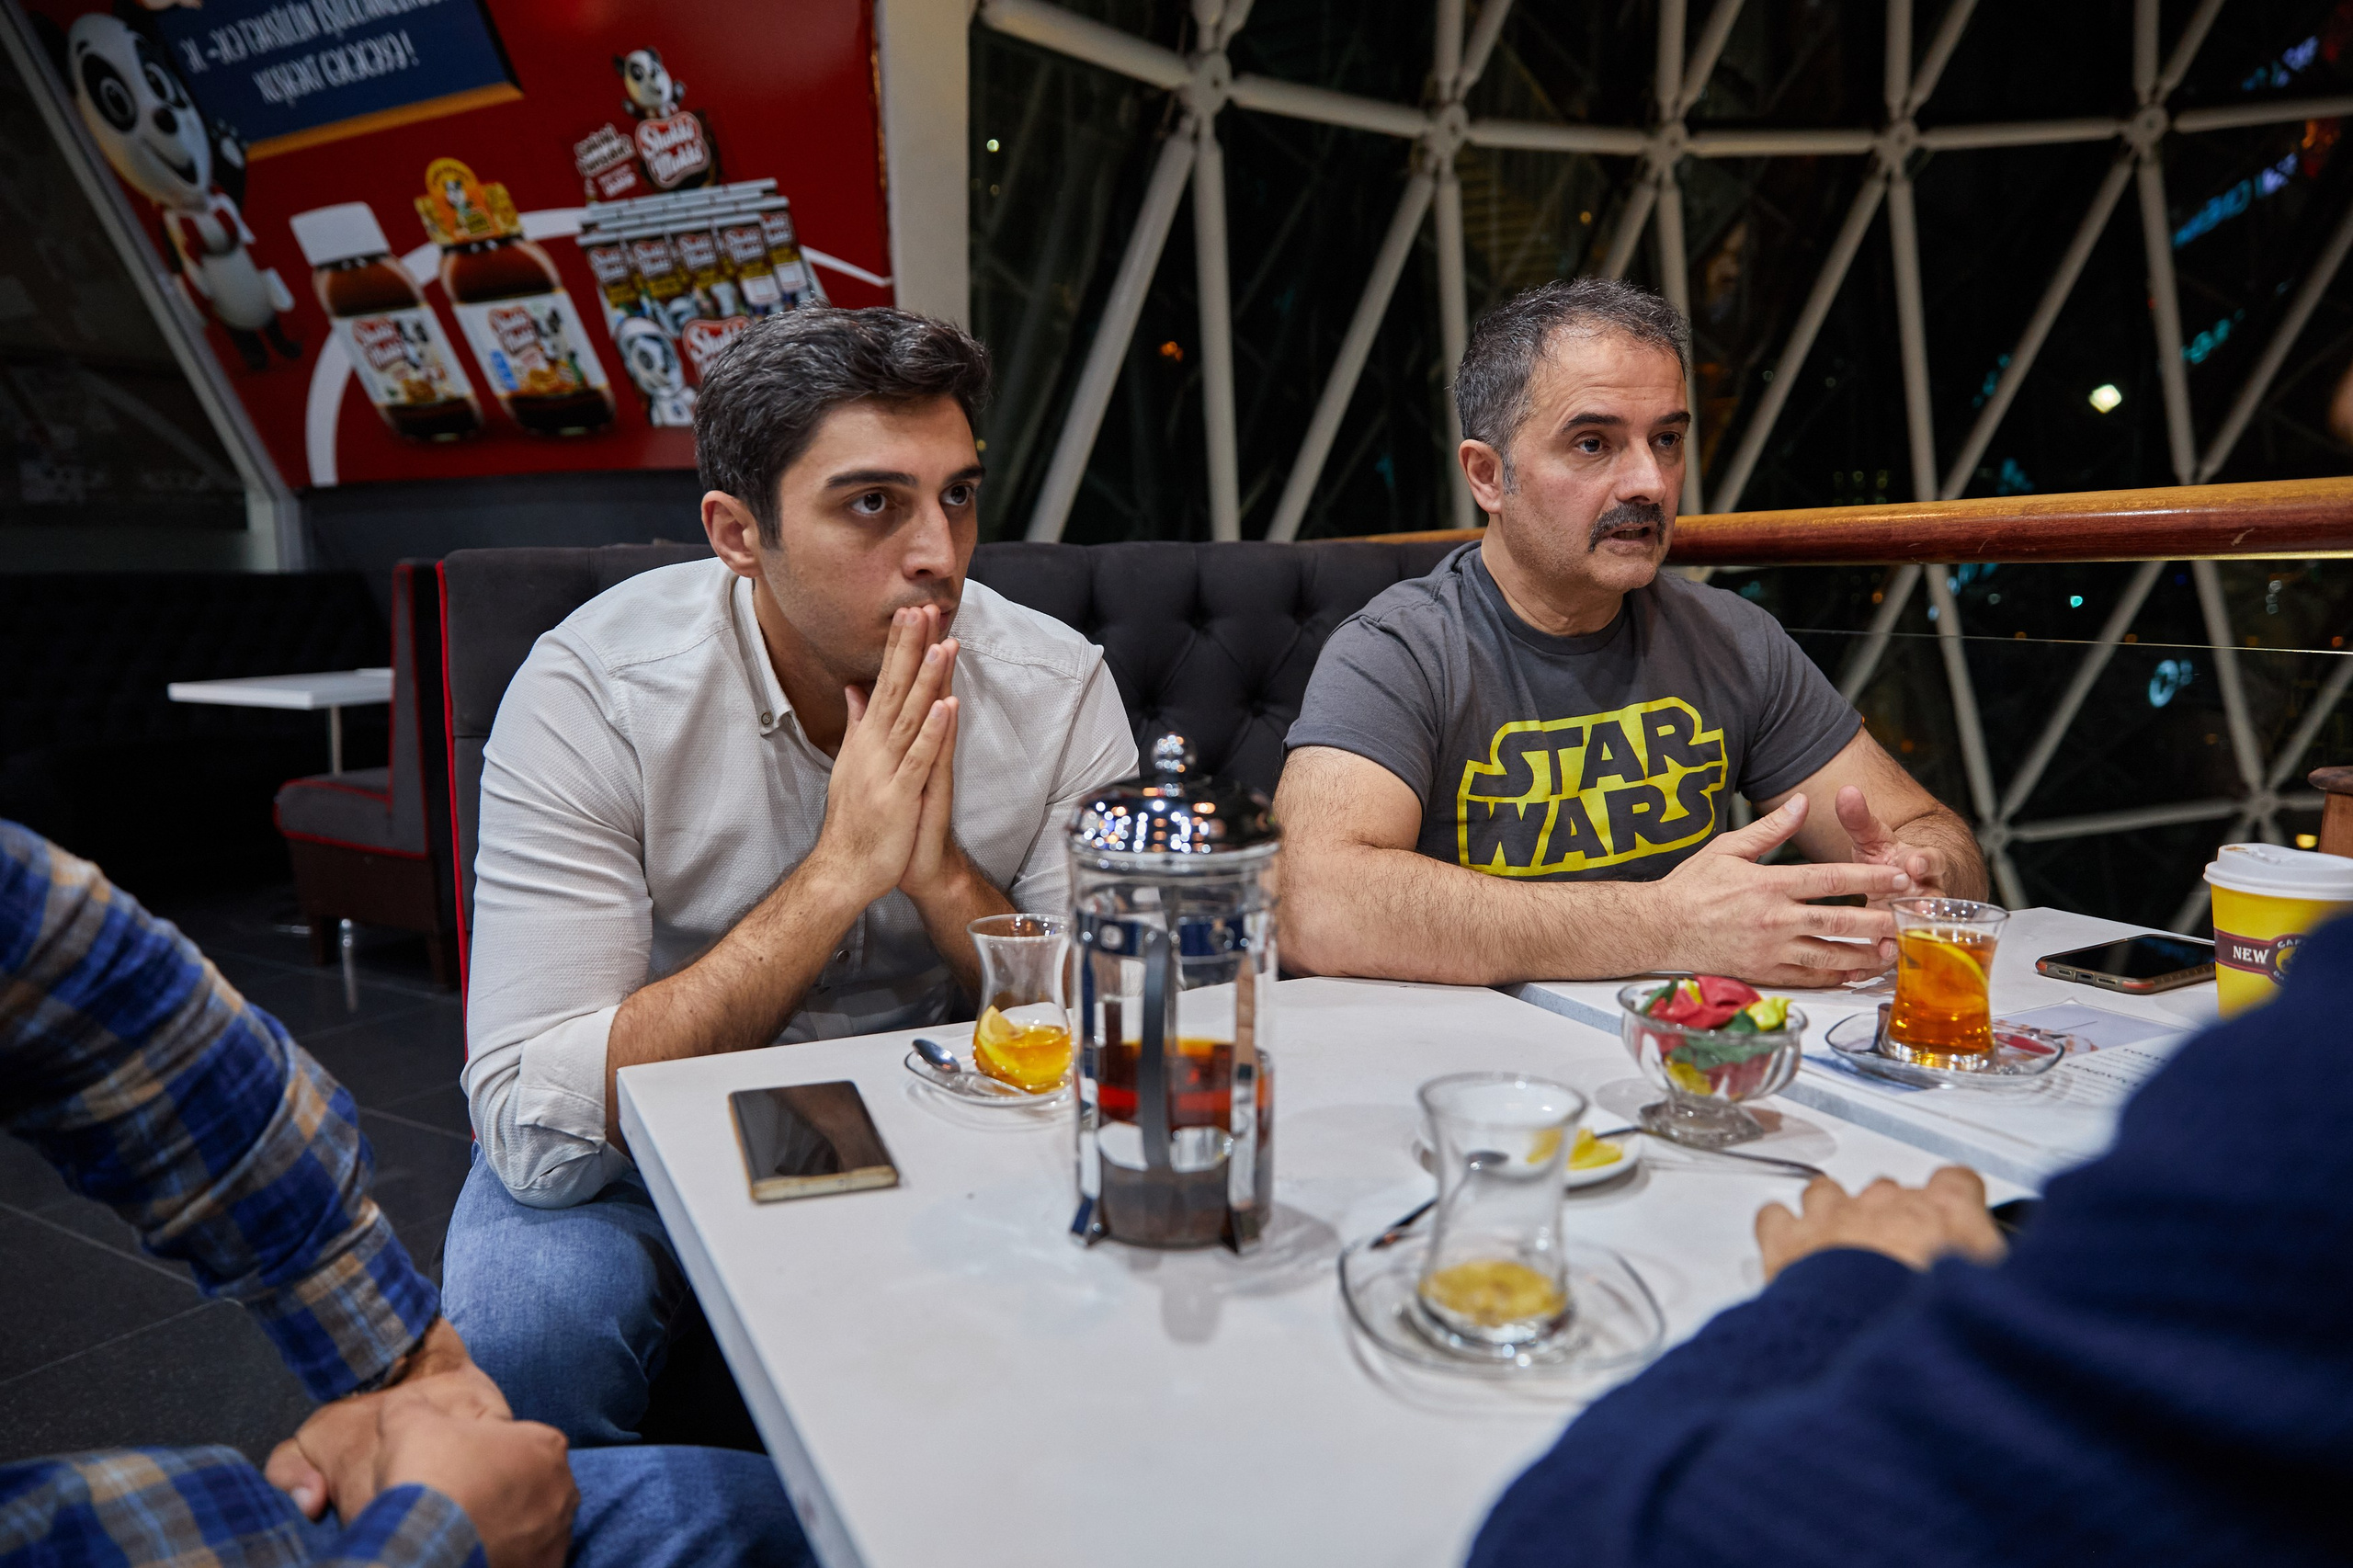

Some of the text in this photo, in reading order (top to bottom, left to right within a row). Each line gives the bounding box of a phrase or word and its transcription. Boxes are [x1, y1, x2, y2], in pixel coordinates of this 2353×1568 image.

[1468, 706, 1723, 799] STAR
[1466, 765, 1722, 868] WARS
[2233, 945, 2269, 965] NEW
